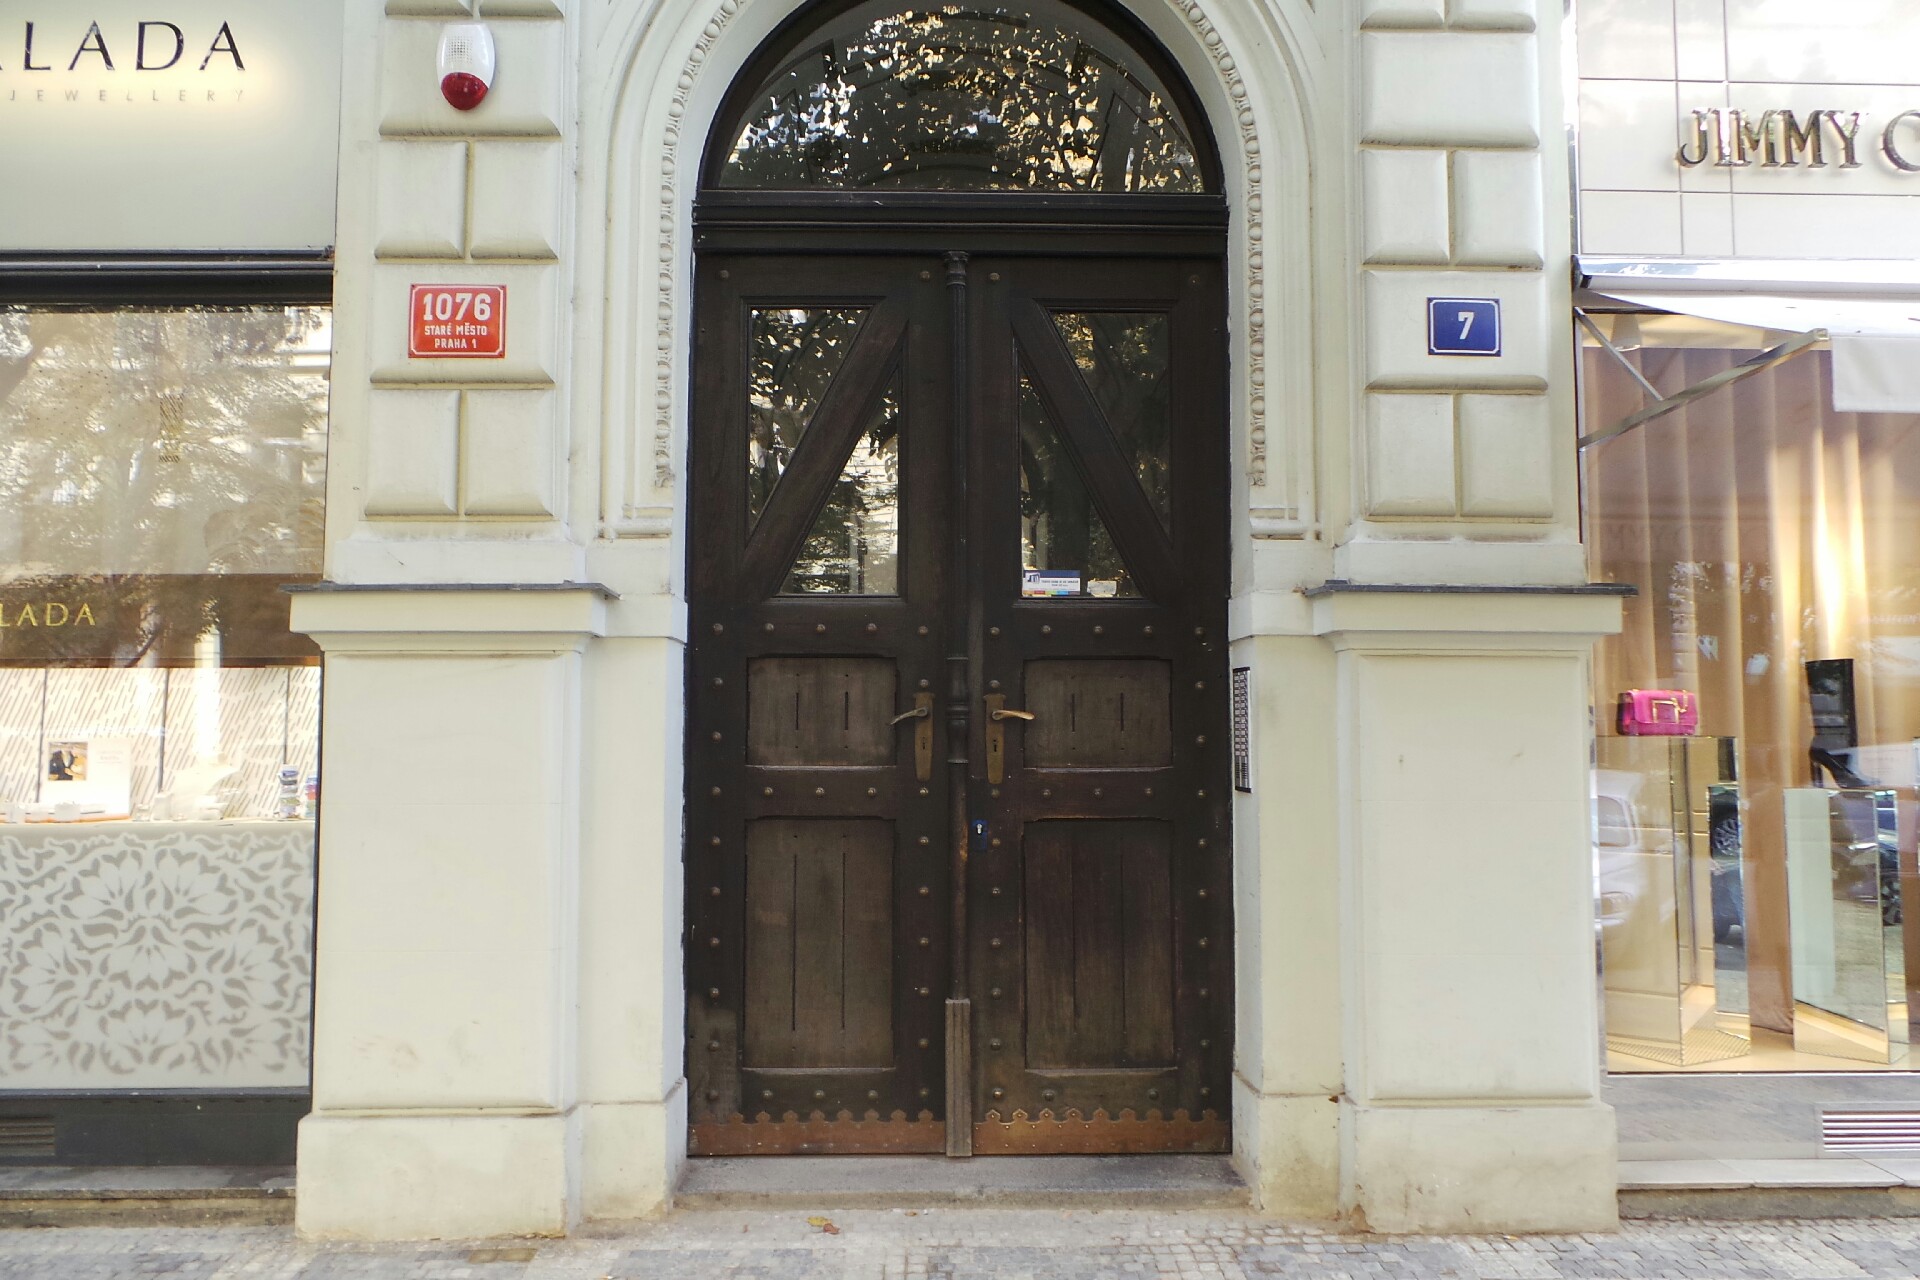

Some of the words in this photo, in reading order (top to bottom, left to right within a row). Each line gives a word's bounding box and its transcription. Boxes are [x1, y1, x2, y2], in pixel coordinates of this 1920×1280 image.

[0, 20, 246, 71] LADA
[9, 89, 244, 102] JEWELLERY
[1675, 107, 1869, 169] JIMMY
[423, 292, 491, 321] 1076
[424, 322, 452, 336] STARÉ
[456, 322, 487, 336] MĚSTO
[1458, 311, 1475, 340] 7
[434, 338, 467, 349] PRAHA
[471, 338, 477, 349] 1
